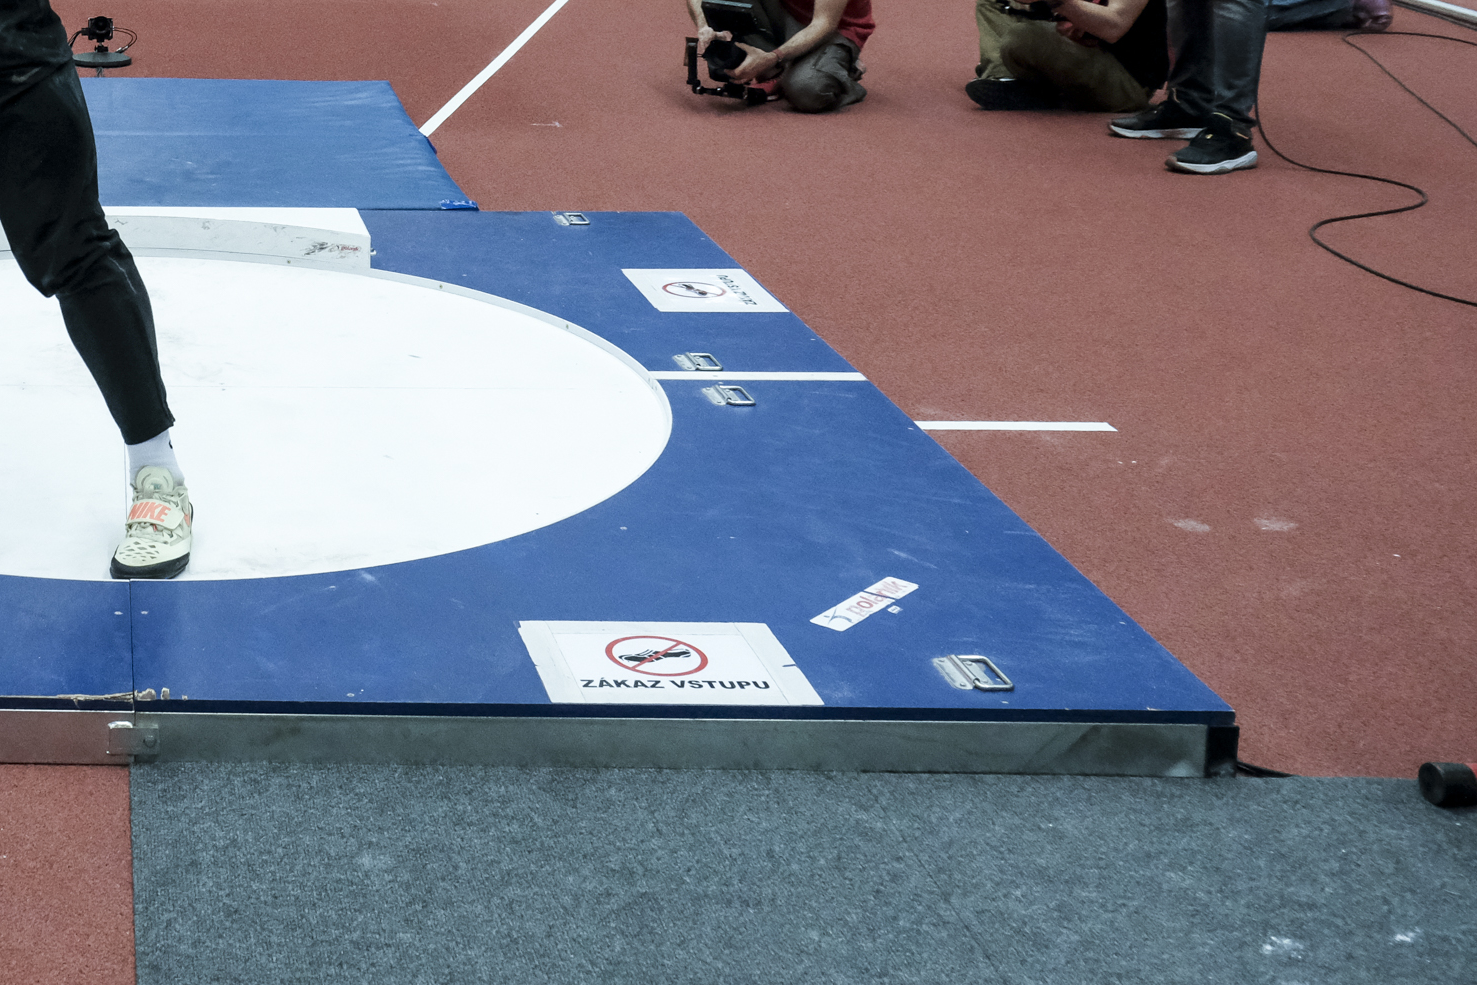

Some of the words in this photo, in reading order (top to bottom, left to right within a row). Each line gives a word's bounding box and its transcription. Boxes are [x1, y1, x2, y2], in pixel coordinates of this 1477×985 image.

[129, 501, 171, 523] NIKE
[846, 581, 908, 618] polanik
[579, 676, 665, 689] ZÁKAZ
[673, 678, 770, 690] VSTUPU
